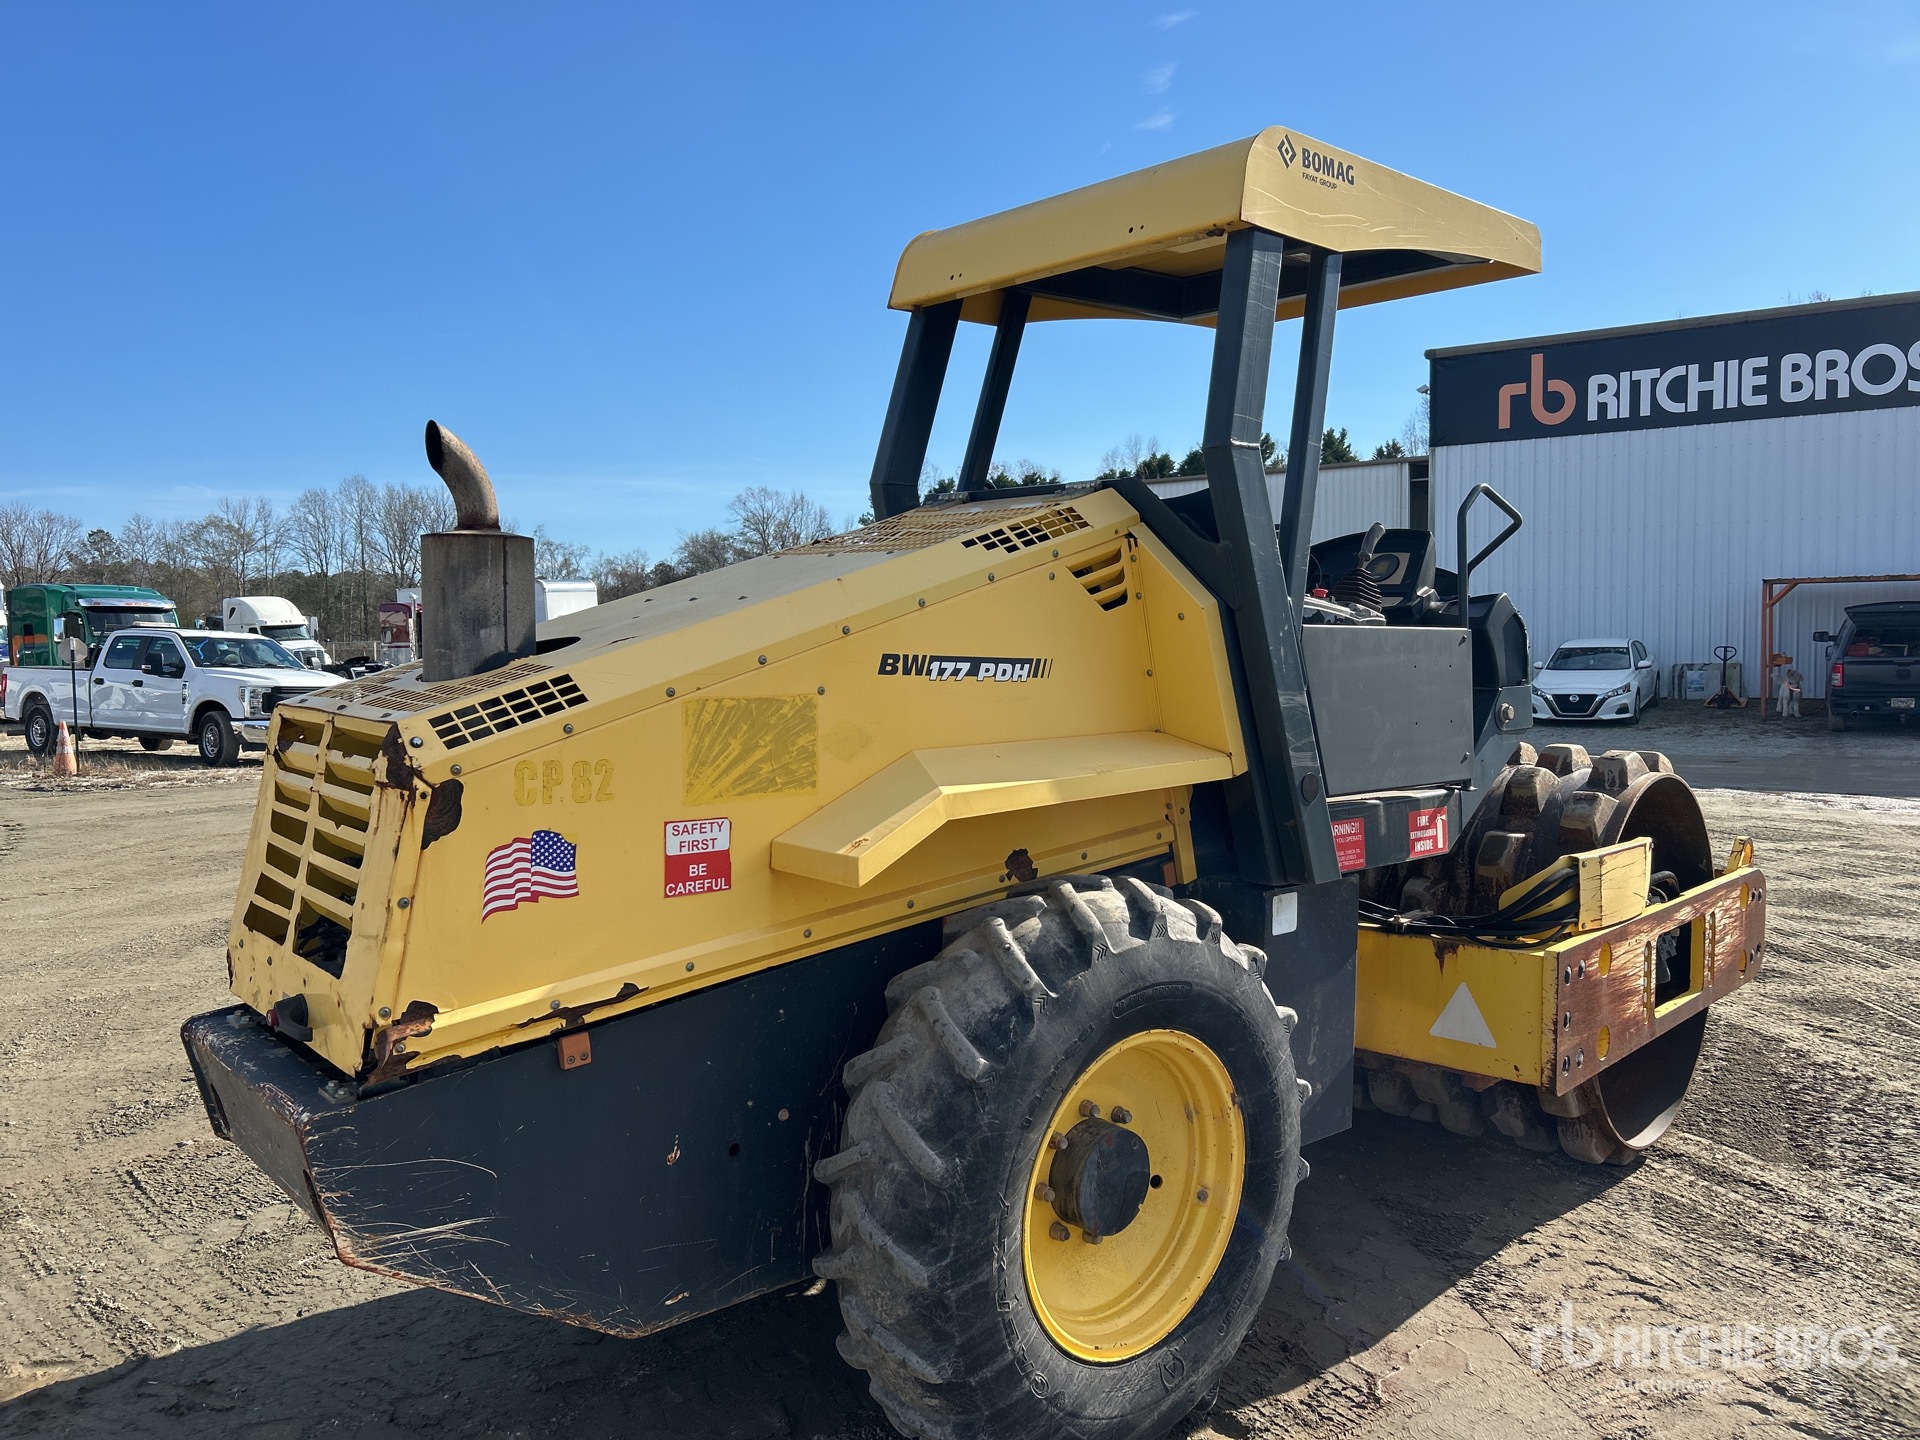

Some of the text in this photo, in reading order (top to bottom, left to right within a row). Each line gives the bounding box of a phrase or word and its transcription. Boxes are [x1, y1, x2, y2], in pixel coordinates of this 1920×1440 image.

[1302, 147, 1355, 186] BOMAG
[1302, 172, 1337, 190] FAYAT GROUP
[1498, 353, 1577, 430] rb
[1587, 356, 1769, 422] RITCHIE
[976, 661, 1031, 683] PDH
[671, 820, 725, 837] SAFETY
[1331, 821, 1360, 836] RNING!!
[1417, 815, 1429, 827] FIRE
[1345, 834, 1363, 843] OPERATE
[1410, 828, 1437, 840] EXTINGUISHER
[679, 837, 718, 853] FIRST
[1414, 839, 1434, 852] INSIDE
[689, 863, 708, 877] BE
[666, 877, 730, 896] CAREFUL
[991, 1190, 1052, 1399] GALAXY
